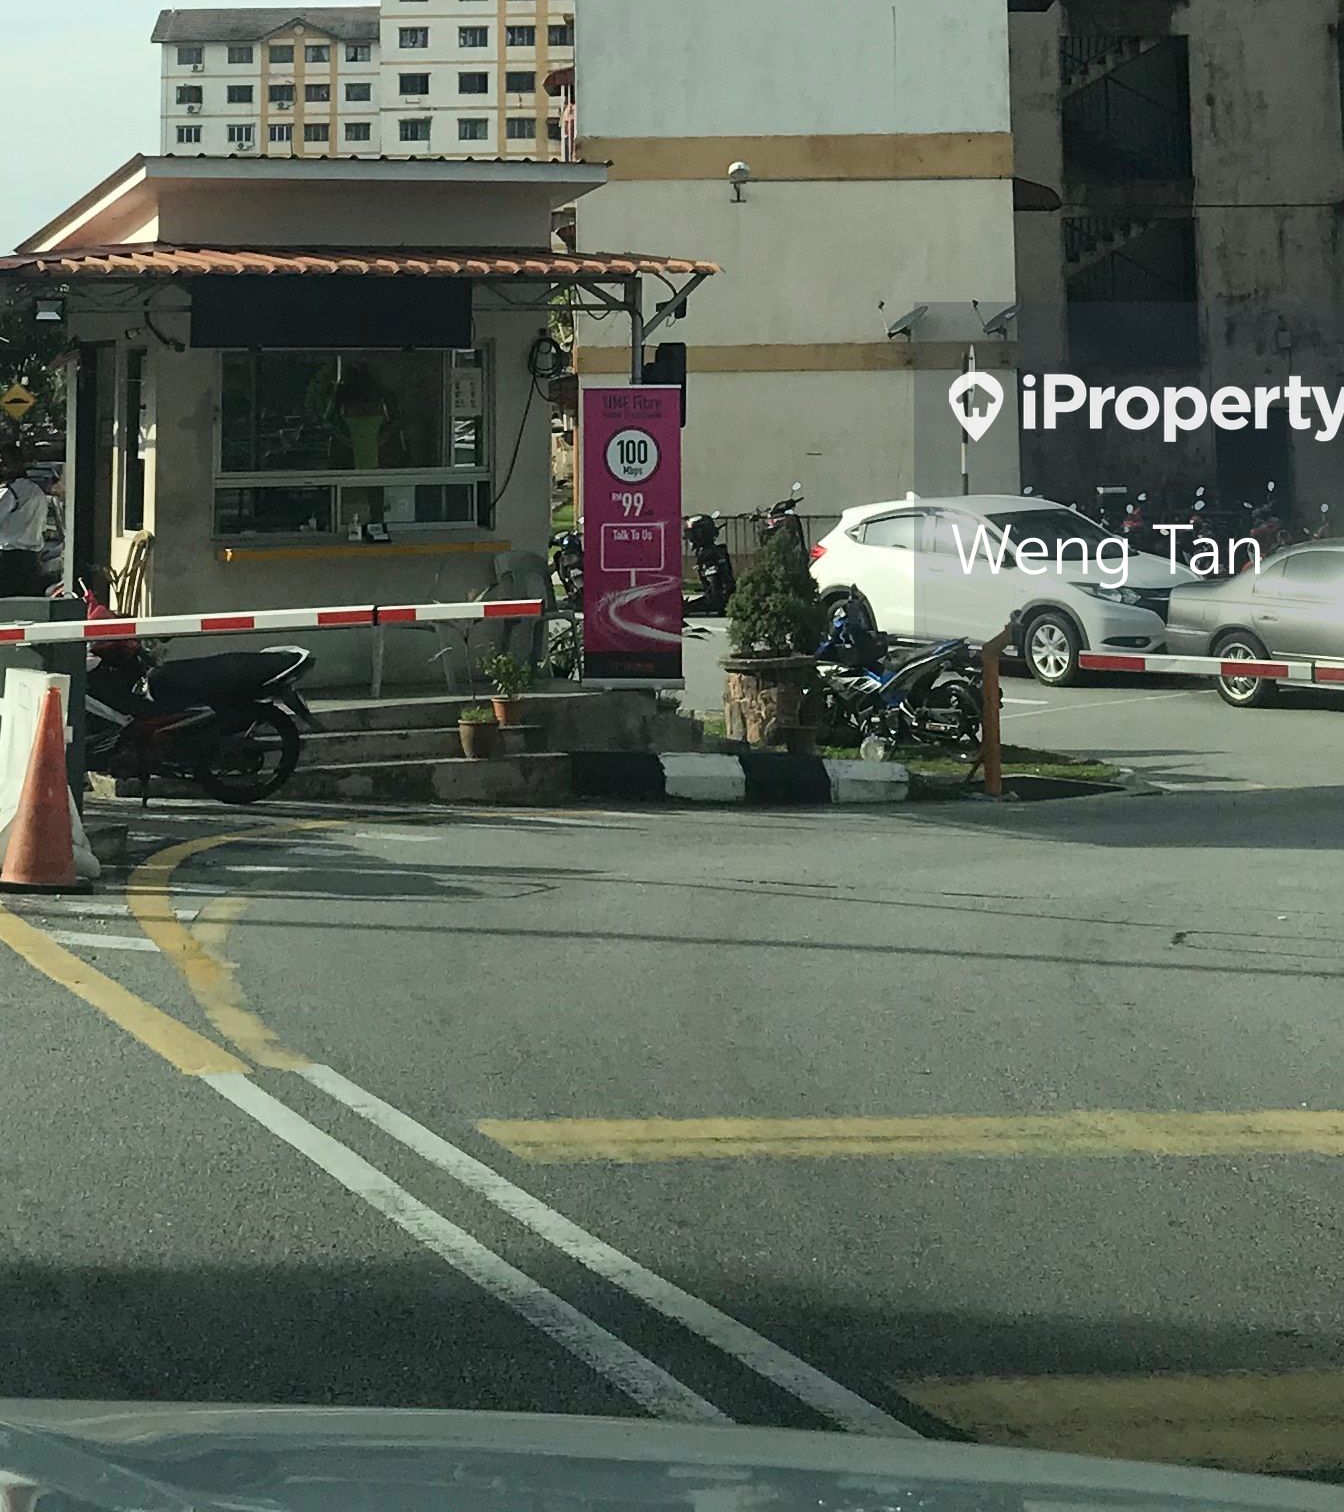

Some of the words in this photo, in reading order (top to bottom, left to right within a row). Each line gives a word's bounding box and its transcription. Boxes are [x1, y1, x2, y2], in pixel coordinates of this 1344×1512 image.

[617, 439, 648, 465] 100
[623, 466, 644, 477] Mbps
[613, 529, 630, 541] Talk
[630, 529, 640, 540] To
